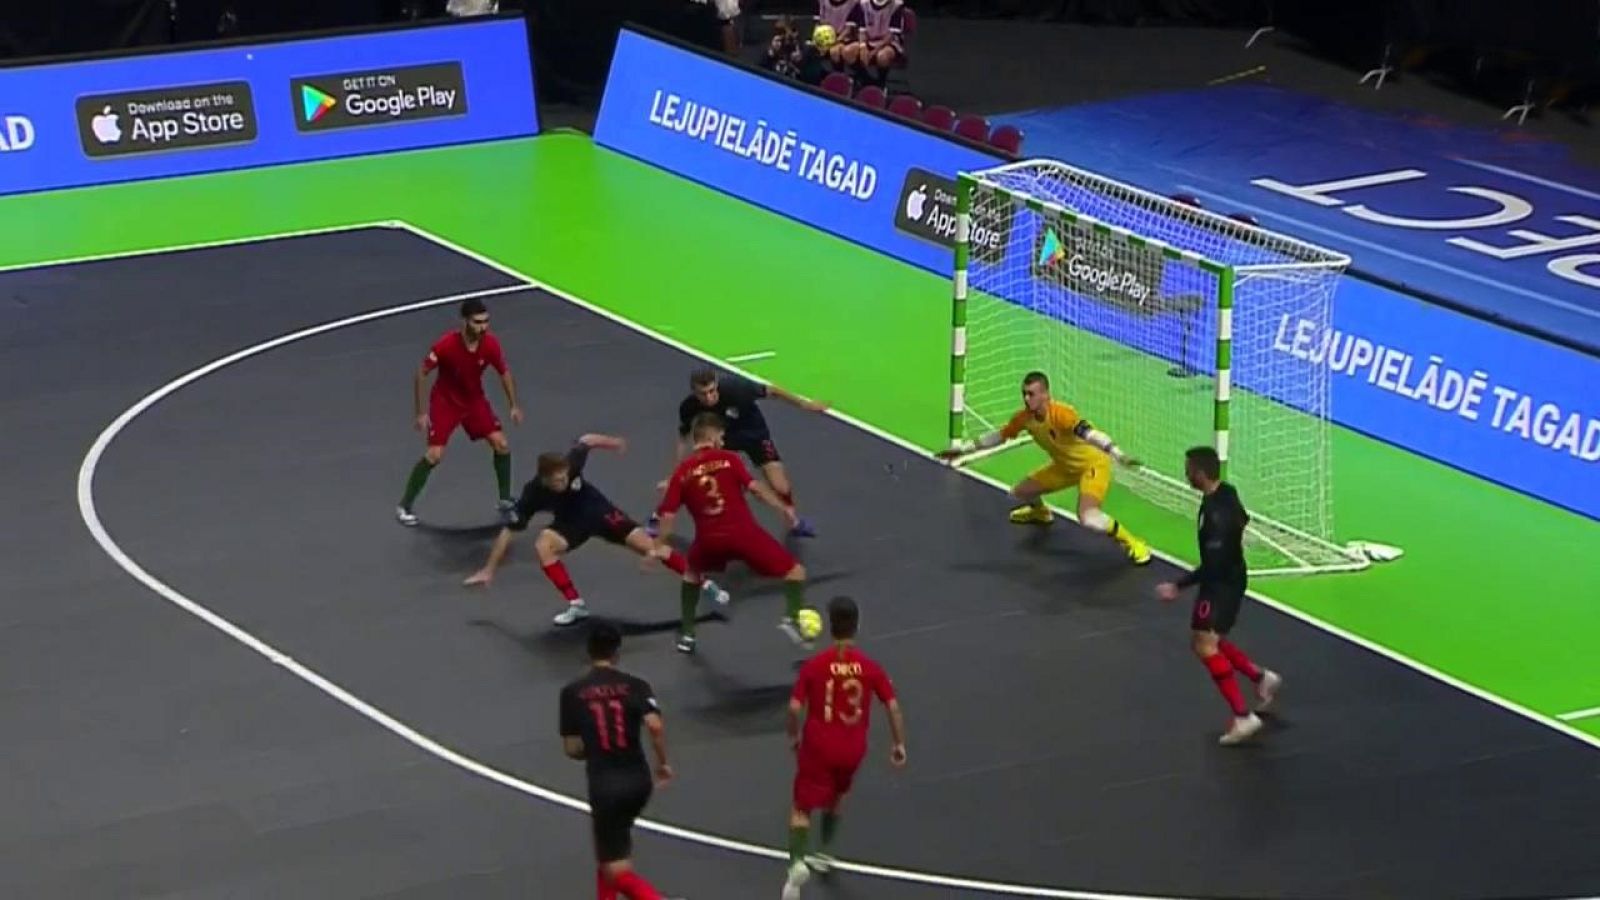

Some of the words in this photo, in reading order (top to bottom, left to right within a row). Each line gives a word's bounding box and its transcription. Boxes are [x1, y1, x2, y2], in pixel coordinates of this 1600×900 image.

[344, 77, 364, 91] GET
[366, 76, 376, 89] IT
[378, 75, 396, 87] ON
[345, 89, 415, 116] Google
[417, 85, 456, 109] Play
[128, 96, 191, 116] Download
[194, 98, 211, 109] on
[213, 94, 233, 106] the
[132, 116, 179, 143] App
[183, 111, 244, 134] Store
[649, 89, 798, 171] LEJUPIELĀDĒ
[797, 141, 877, 200] TAGAD
[1069, 254, 1119, 292] Google
[1119, 271, 1150, 306] Play
[1274, 312, 1488, 420] LEJUPIELĀDĒ
[700, 475, 724, 516] 3
[824, 679, 863, 725] 13
[588, 699, 629, 751] 11
